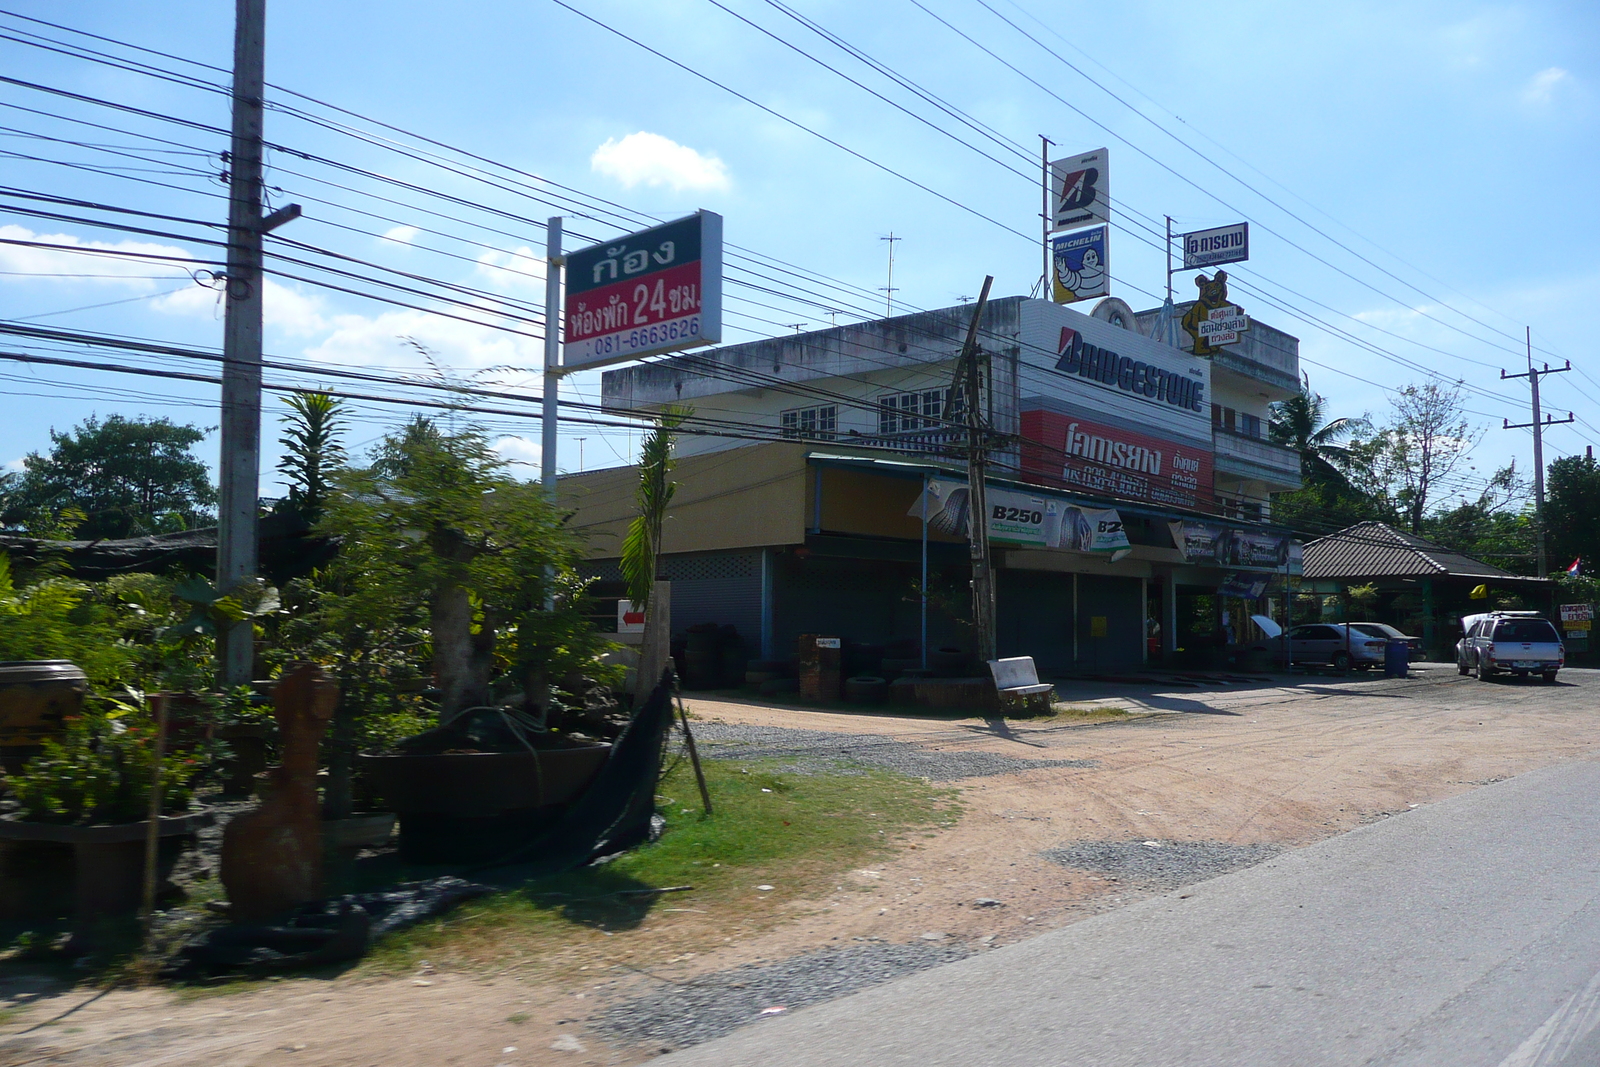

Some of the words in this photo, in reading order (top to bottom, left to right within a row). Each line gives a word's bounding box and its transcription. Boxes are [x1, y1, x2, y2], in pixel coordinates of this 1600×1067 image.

[592, 240, 676, 284] ก้อง
[1055, 233, 1103, 251] MICHELIN
[570, 293, 628, 337] ห้องพัก
[633, 278, 667, 325] 24
[1055, 326, 1205, 413] BRIDGESTONE
[992, 505, 1043, 525] B250
